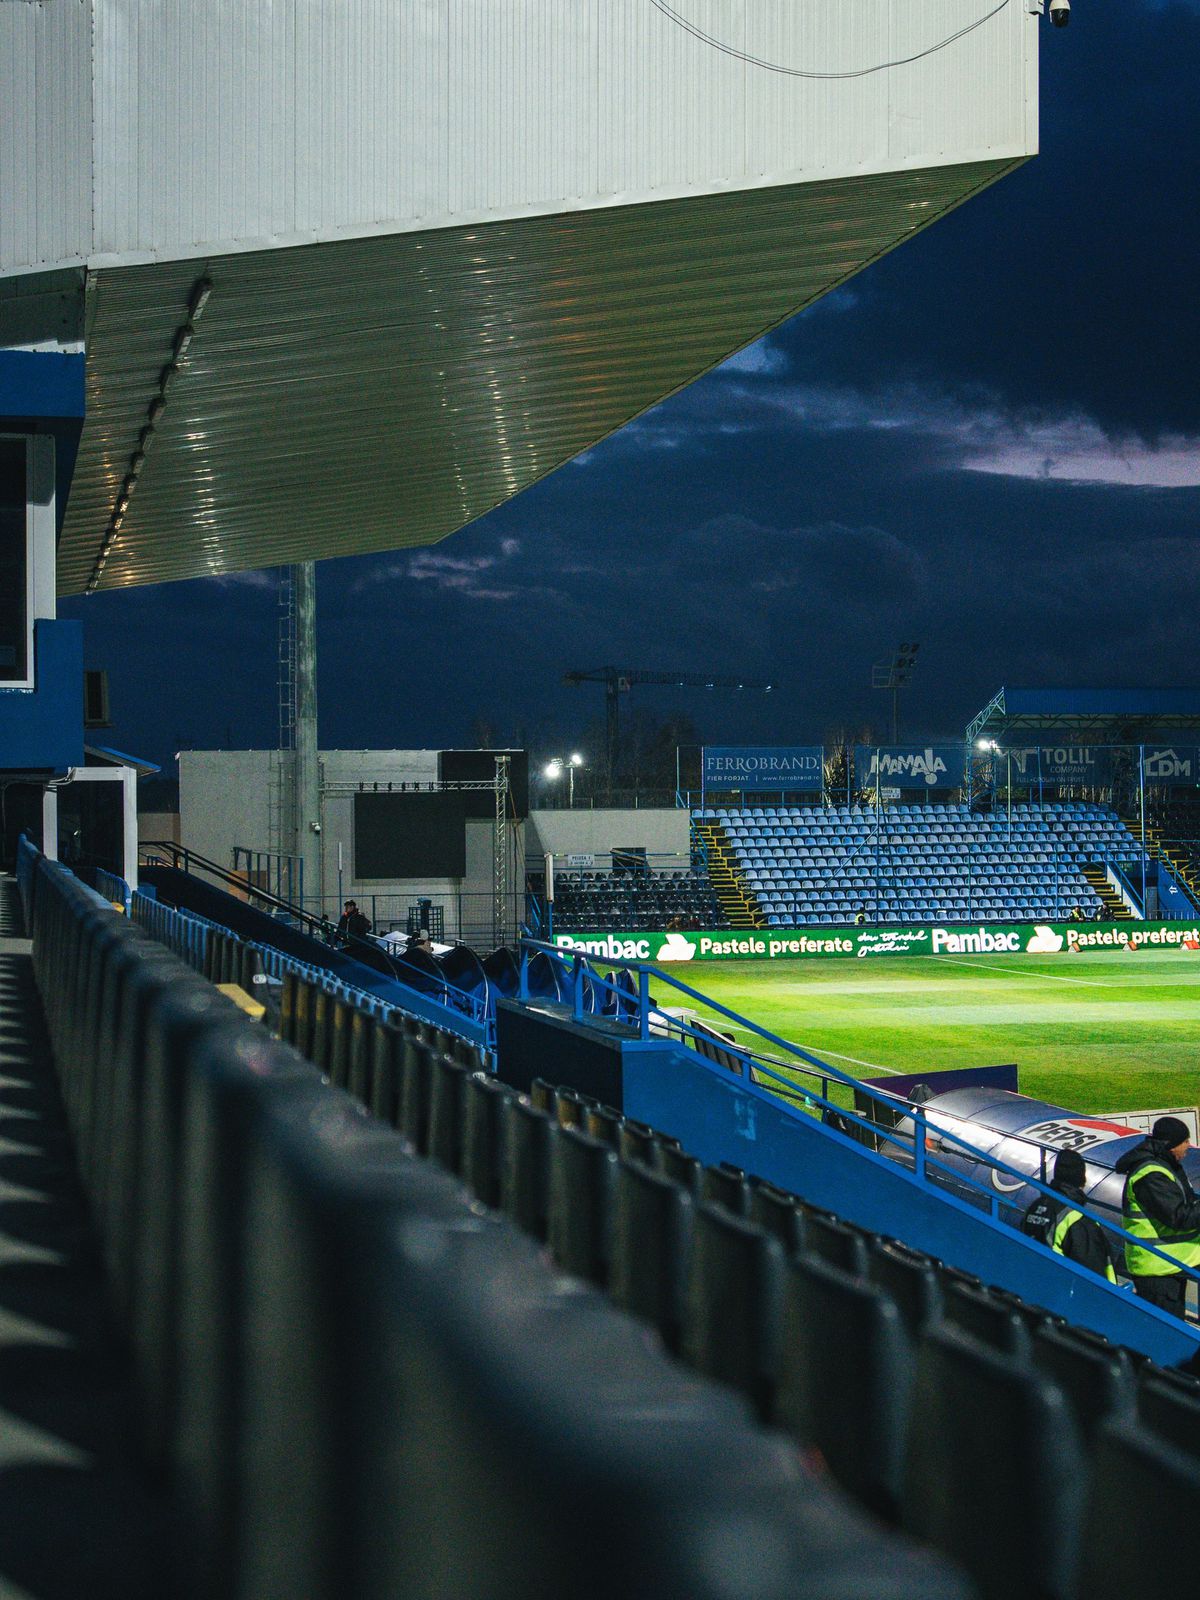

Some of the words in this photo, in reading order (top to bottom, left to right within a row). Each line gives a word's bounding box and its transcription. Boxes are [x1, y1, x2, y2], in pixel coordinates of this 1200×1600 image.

[1042, 748, 1095, 764] TOLIL
[1050, 766, 1088, 774] COMPANY
[700, 937, 766, 954] Pastele
[769, 936, 853, 957] preferate
[932, 927, 1020, 953] Pambac
[1066, 928, 1128, 946] Pastele
[1131, 927, 1200, 945] preferat
[556, 935, 650, 960] Pambac
[1025, 1122, 1104, 1150] PEPSI
